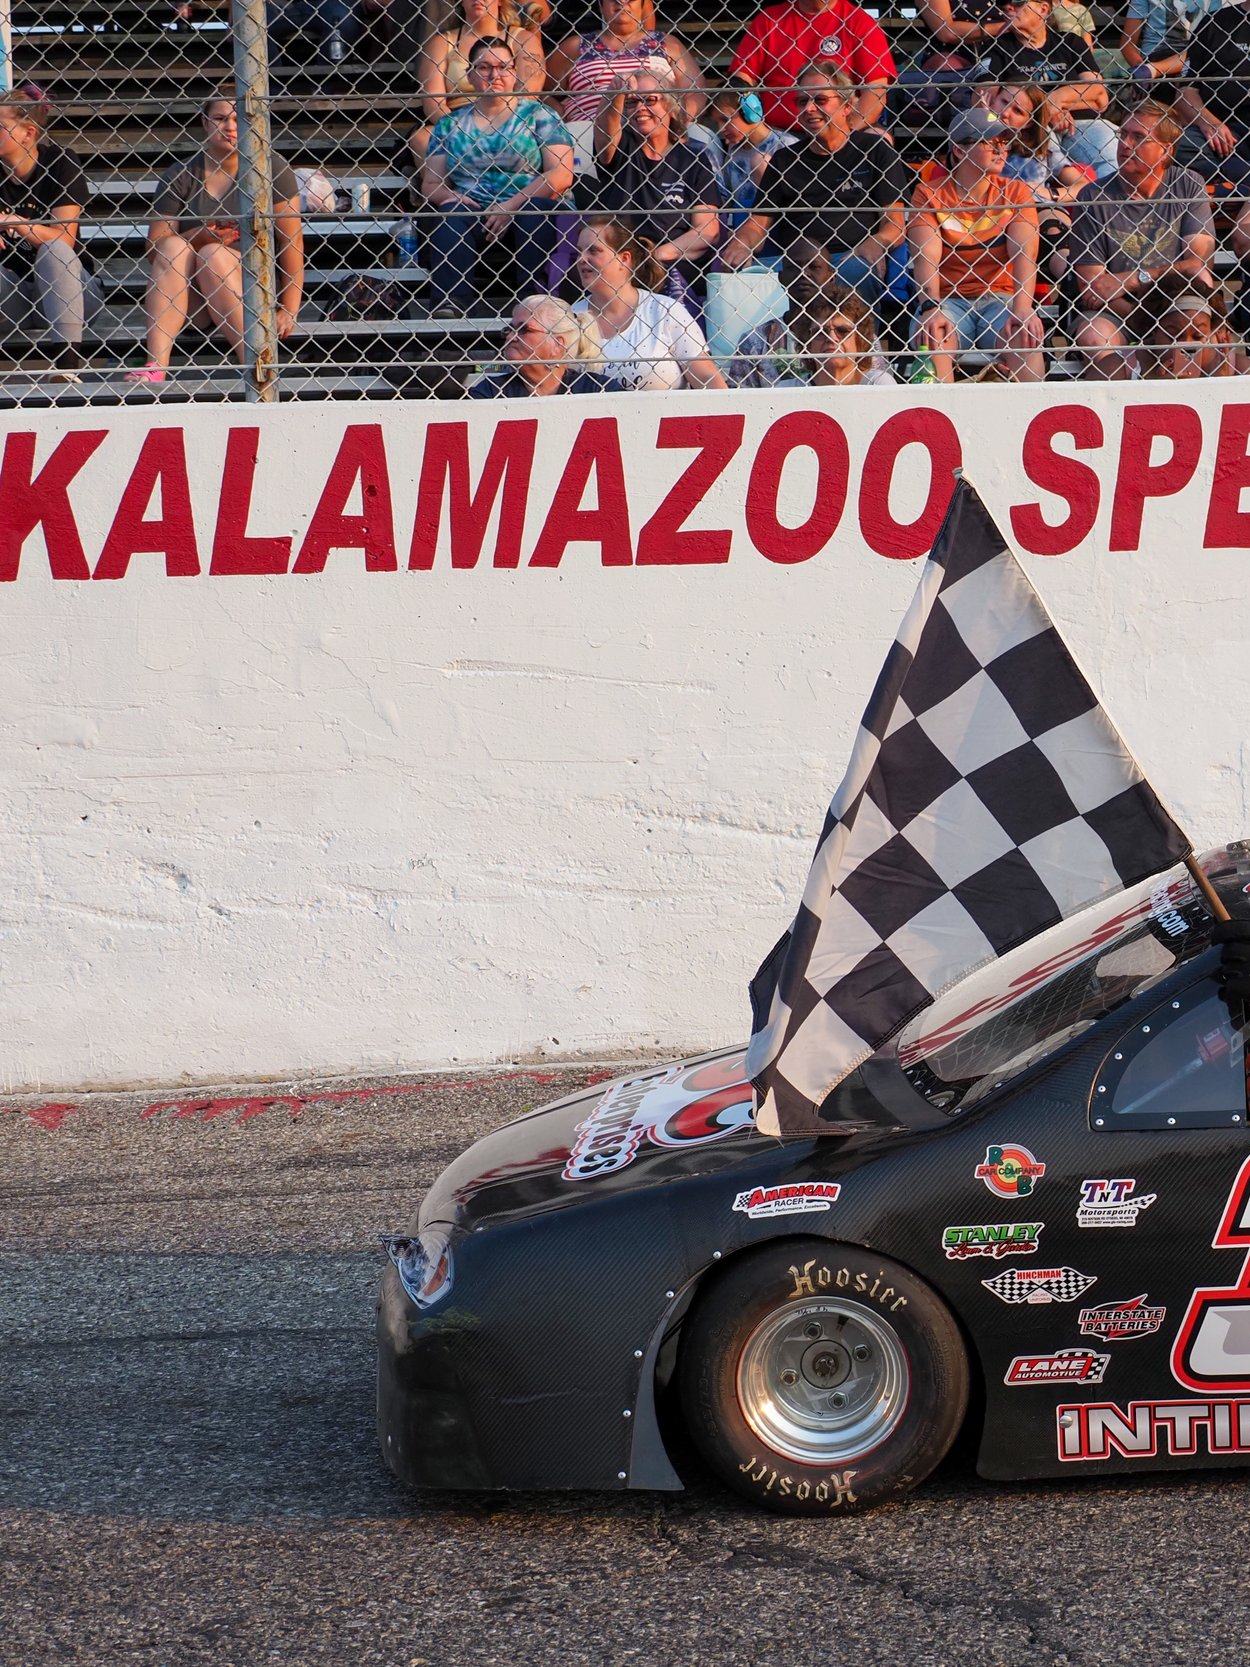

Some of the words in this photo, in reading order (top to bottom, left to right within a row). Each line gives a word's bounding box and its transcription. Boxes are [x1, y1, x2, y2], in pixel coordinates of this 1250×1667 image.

[0, 406, 962, 581] KALAMAZOO
[979, 1168, 997, 1176] CAR
[998, 1167, 1041, 1176] COMPANY
[988, 1147, 1004, 1166] R
[1017, 1175, 1032, 1195] B
[748, 1184, 838, 1208] AMERICAN
[1083, 1182, 1133, 1202] TNT
[774, 1198, 804, 1207] RACER
[1079, 1208, 1137, 1217] Motorsports
[944, 1224, 1041, 1243] STANLEY
[948, 1241, 982, 1257] Lawn
[1017, 1269, 1062, 1280] HINCHMAN
[787, 1258, 908, 1313] Hoosier
[1083, 1310, 1162, 1321] INTERSTATE
[1086, 1320, 1157, 1331] BATTERIES
[1018, 1359, 1087, 1372] LANE
[1014, 1370, 1082, 1379] AUTOMOTIVE
[738, 1456, 858, 1508] Hoosier
